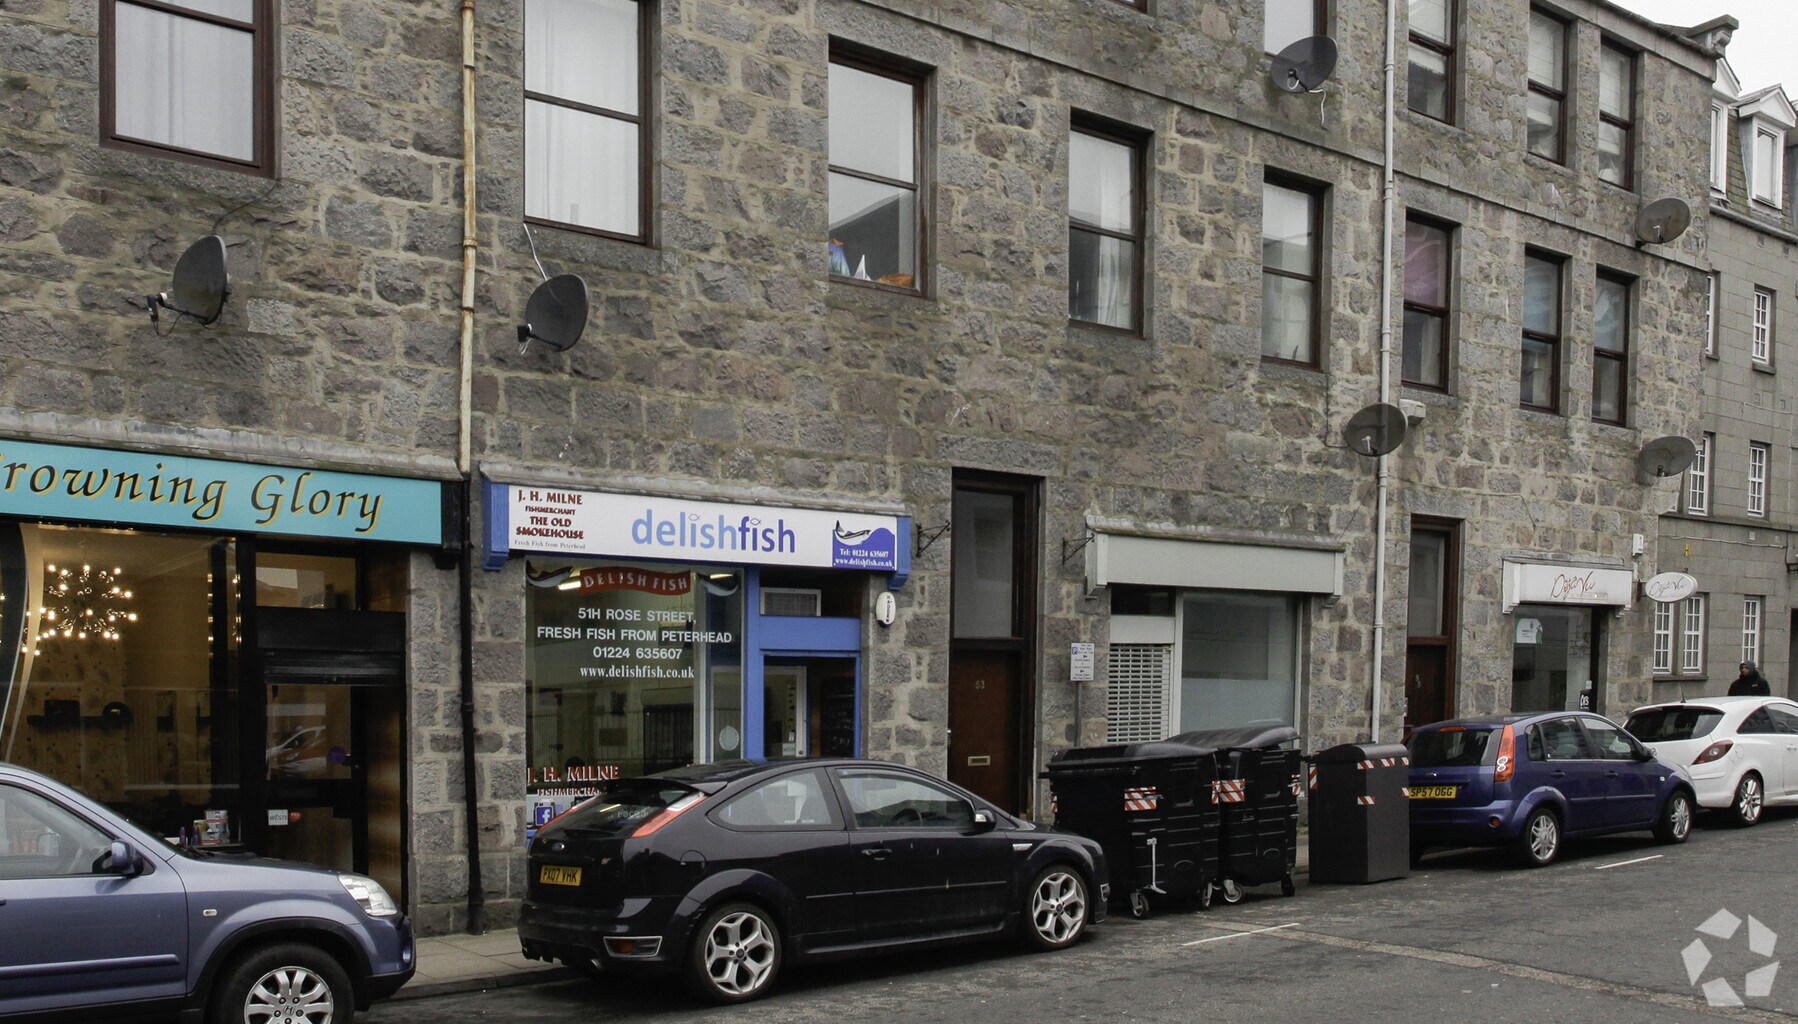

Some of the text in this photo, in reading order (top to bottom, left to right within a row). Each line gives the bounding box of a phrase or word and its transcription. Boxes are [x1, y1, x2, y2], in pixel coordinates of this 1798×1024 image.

[0, 453, 383, 534] rowning Glory
[518, 489, 583, 505] J. H. MILNE
[530, 516, 572, 527] THE OLD
[516, 526, 584, 539] SMOKEHOUSE
[632, 509, 795, 553] delishfish
[583, 572, 688, 591] DELISH FISH
[578, 607, 697, 624] 51H ROSE STREET,
[537, 626, 732, 643] FRESH FISH FROM PETERHEAD
[593, 646, 683, 660] 01224 635607
[580, 665, 695, 679] www.delishfish.co.uk
[543, 767, 561, 782] H.
[567, 764, 620, 782] MILNE
[537, 787, 607, 797] FISHMERCHA
